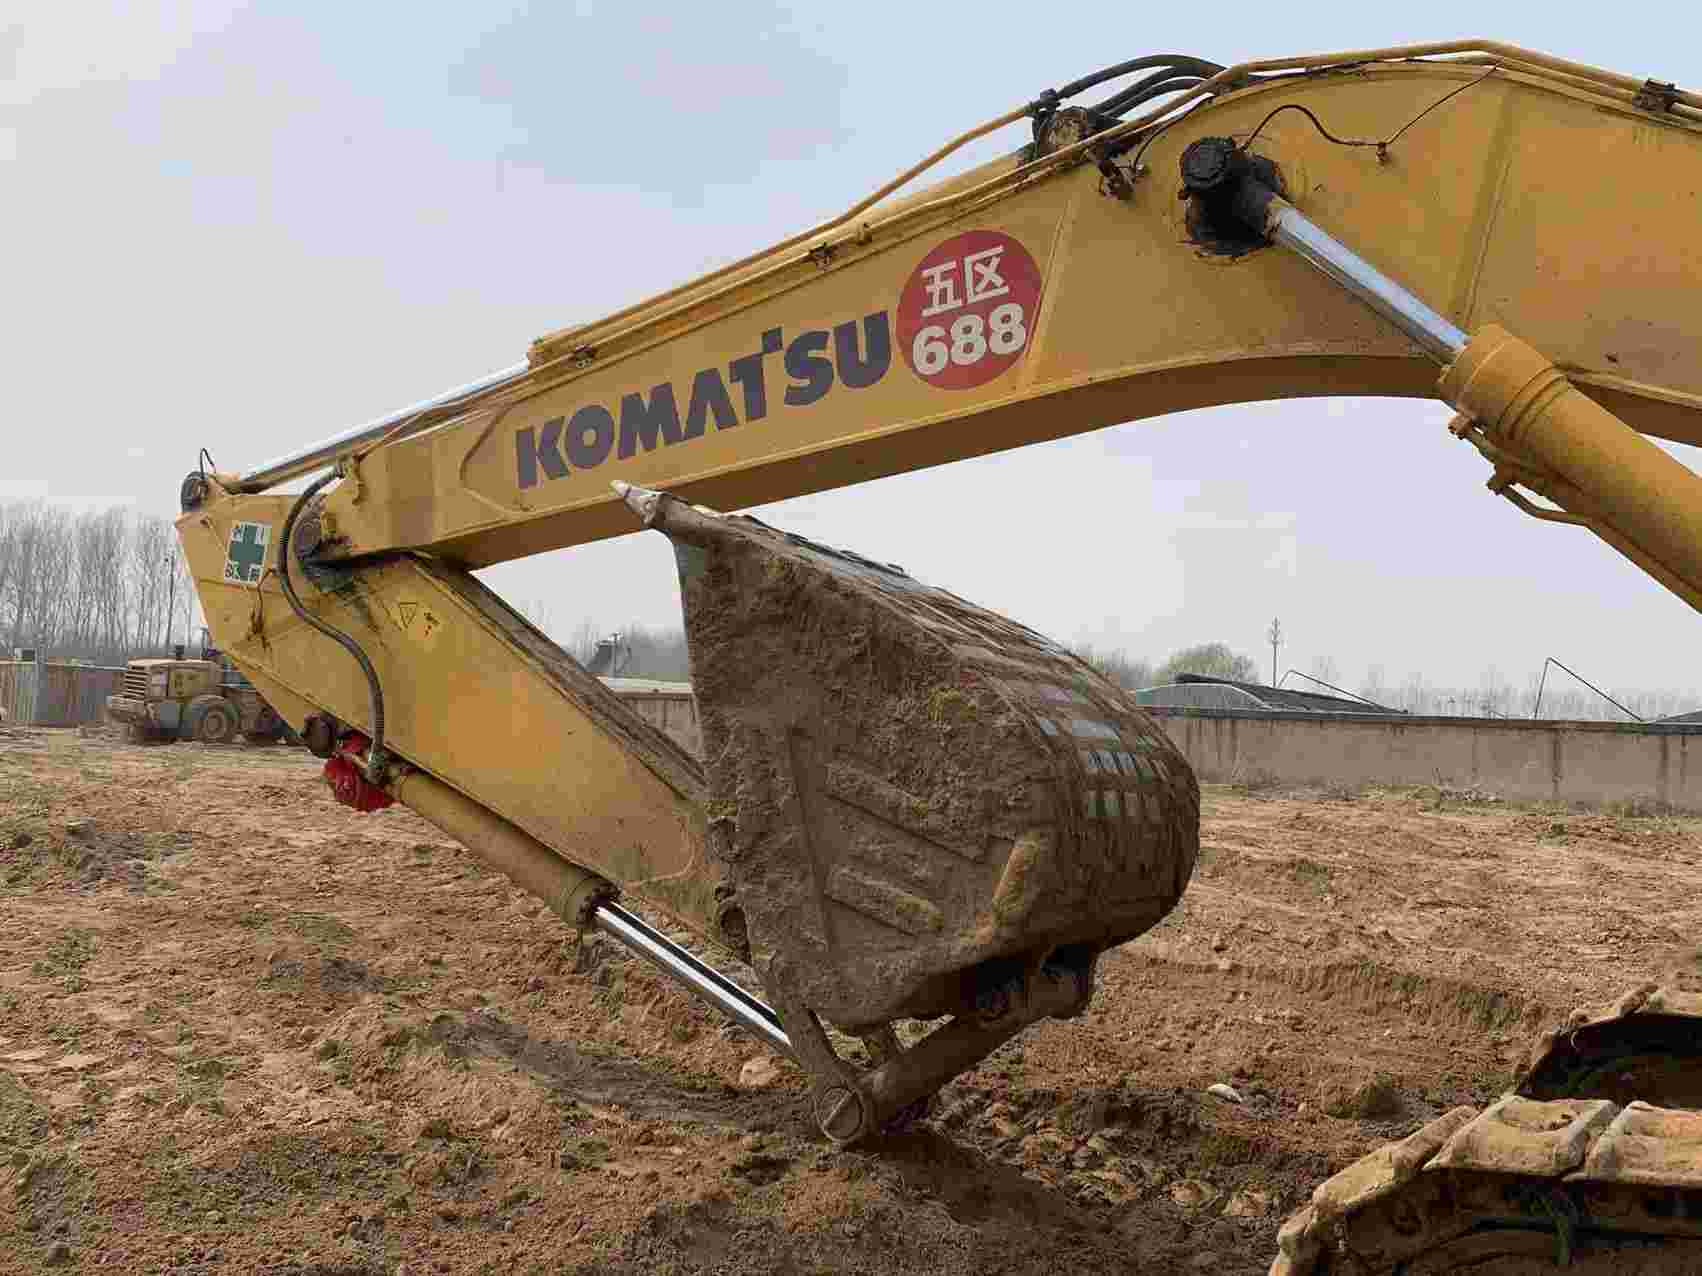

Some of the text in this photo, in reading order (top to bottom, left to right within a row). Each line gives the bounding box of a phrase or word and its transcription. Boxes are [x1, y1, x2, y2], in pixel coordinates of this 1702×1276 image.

[922, 246, 1009, 317] 五区
[912, 302, 1027, 376] 688
[515, 310, 892, 489] KOMATSU
